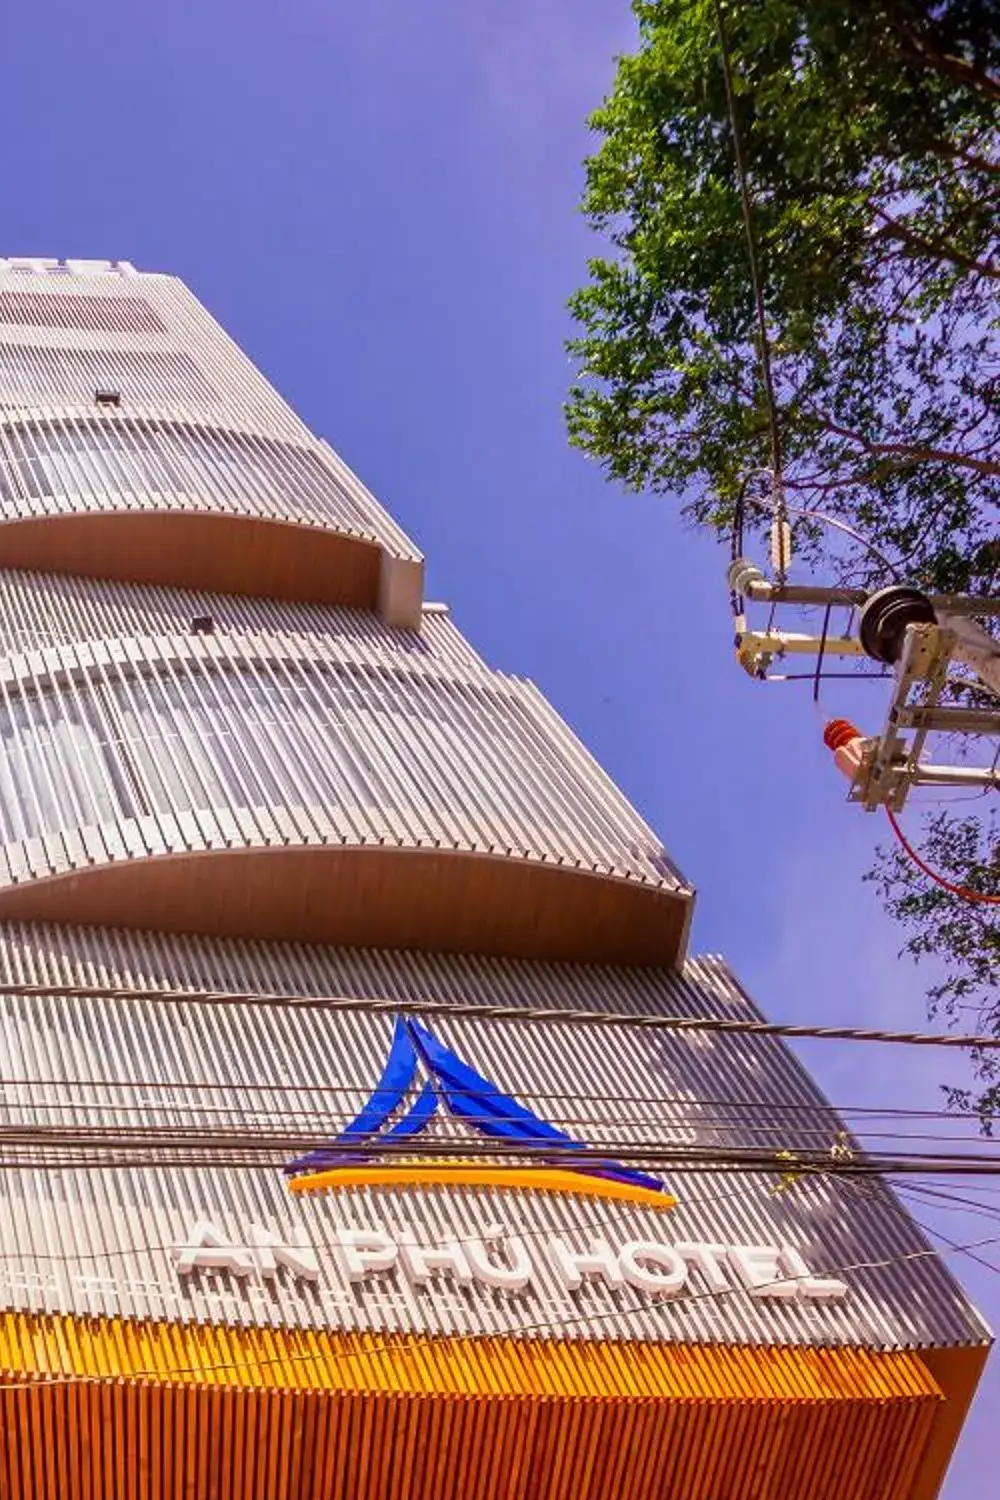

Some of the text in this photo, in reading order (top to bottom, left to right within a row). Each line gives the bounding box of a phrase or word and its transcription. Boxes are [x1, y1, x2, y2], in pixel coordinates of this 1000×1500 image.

[169, 1220, 848, 1298] AN PHÚ HOTEL
